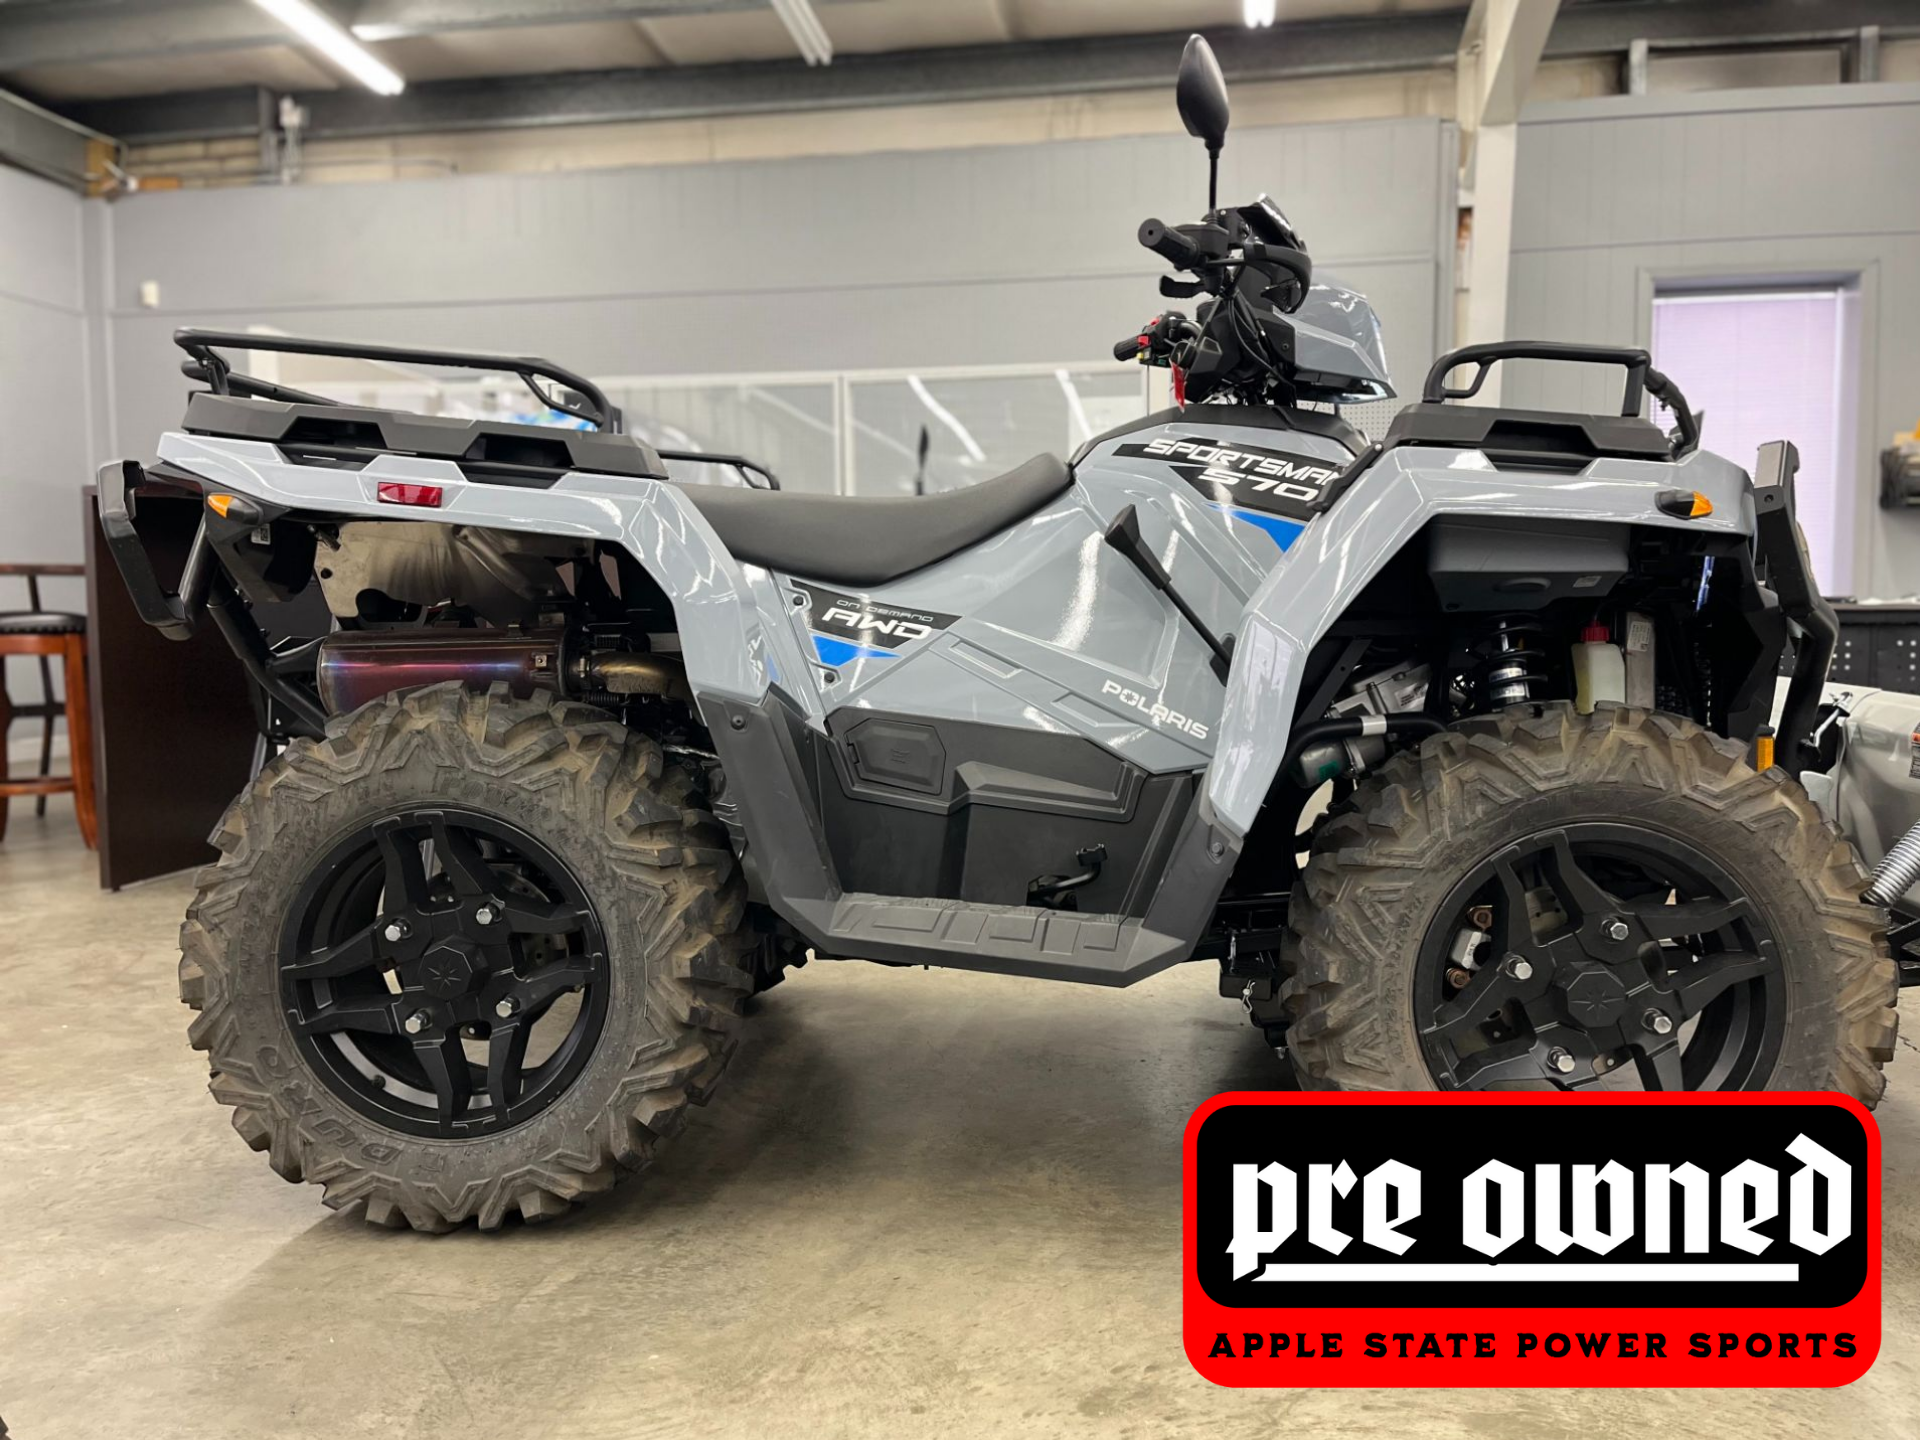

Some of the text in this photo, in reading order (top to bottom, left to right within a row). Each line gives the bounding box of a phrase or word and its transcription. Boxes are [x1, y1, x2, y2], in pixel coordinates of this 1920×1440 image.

[1198, 468, 1319, 501] 570
[821, 607, 933, 640] AWD
[866, 606, 934, 623] DEMAND
[1101, 679, 1209, 740] POLARIS
